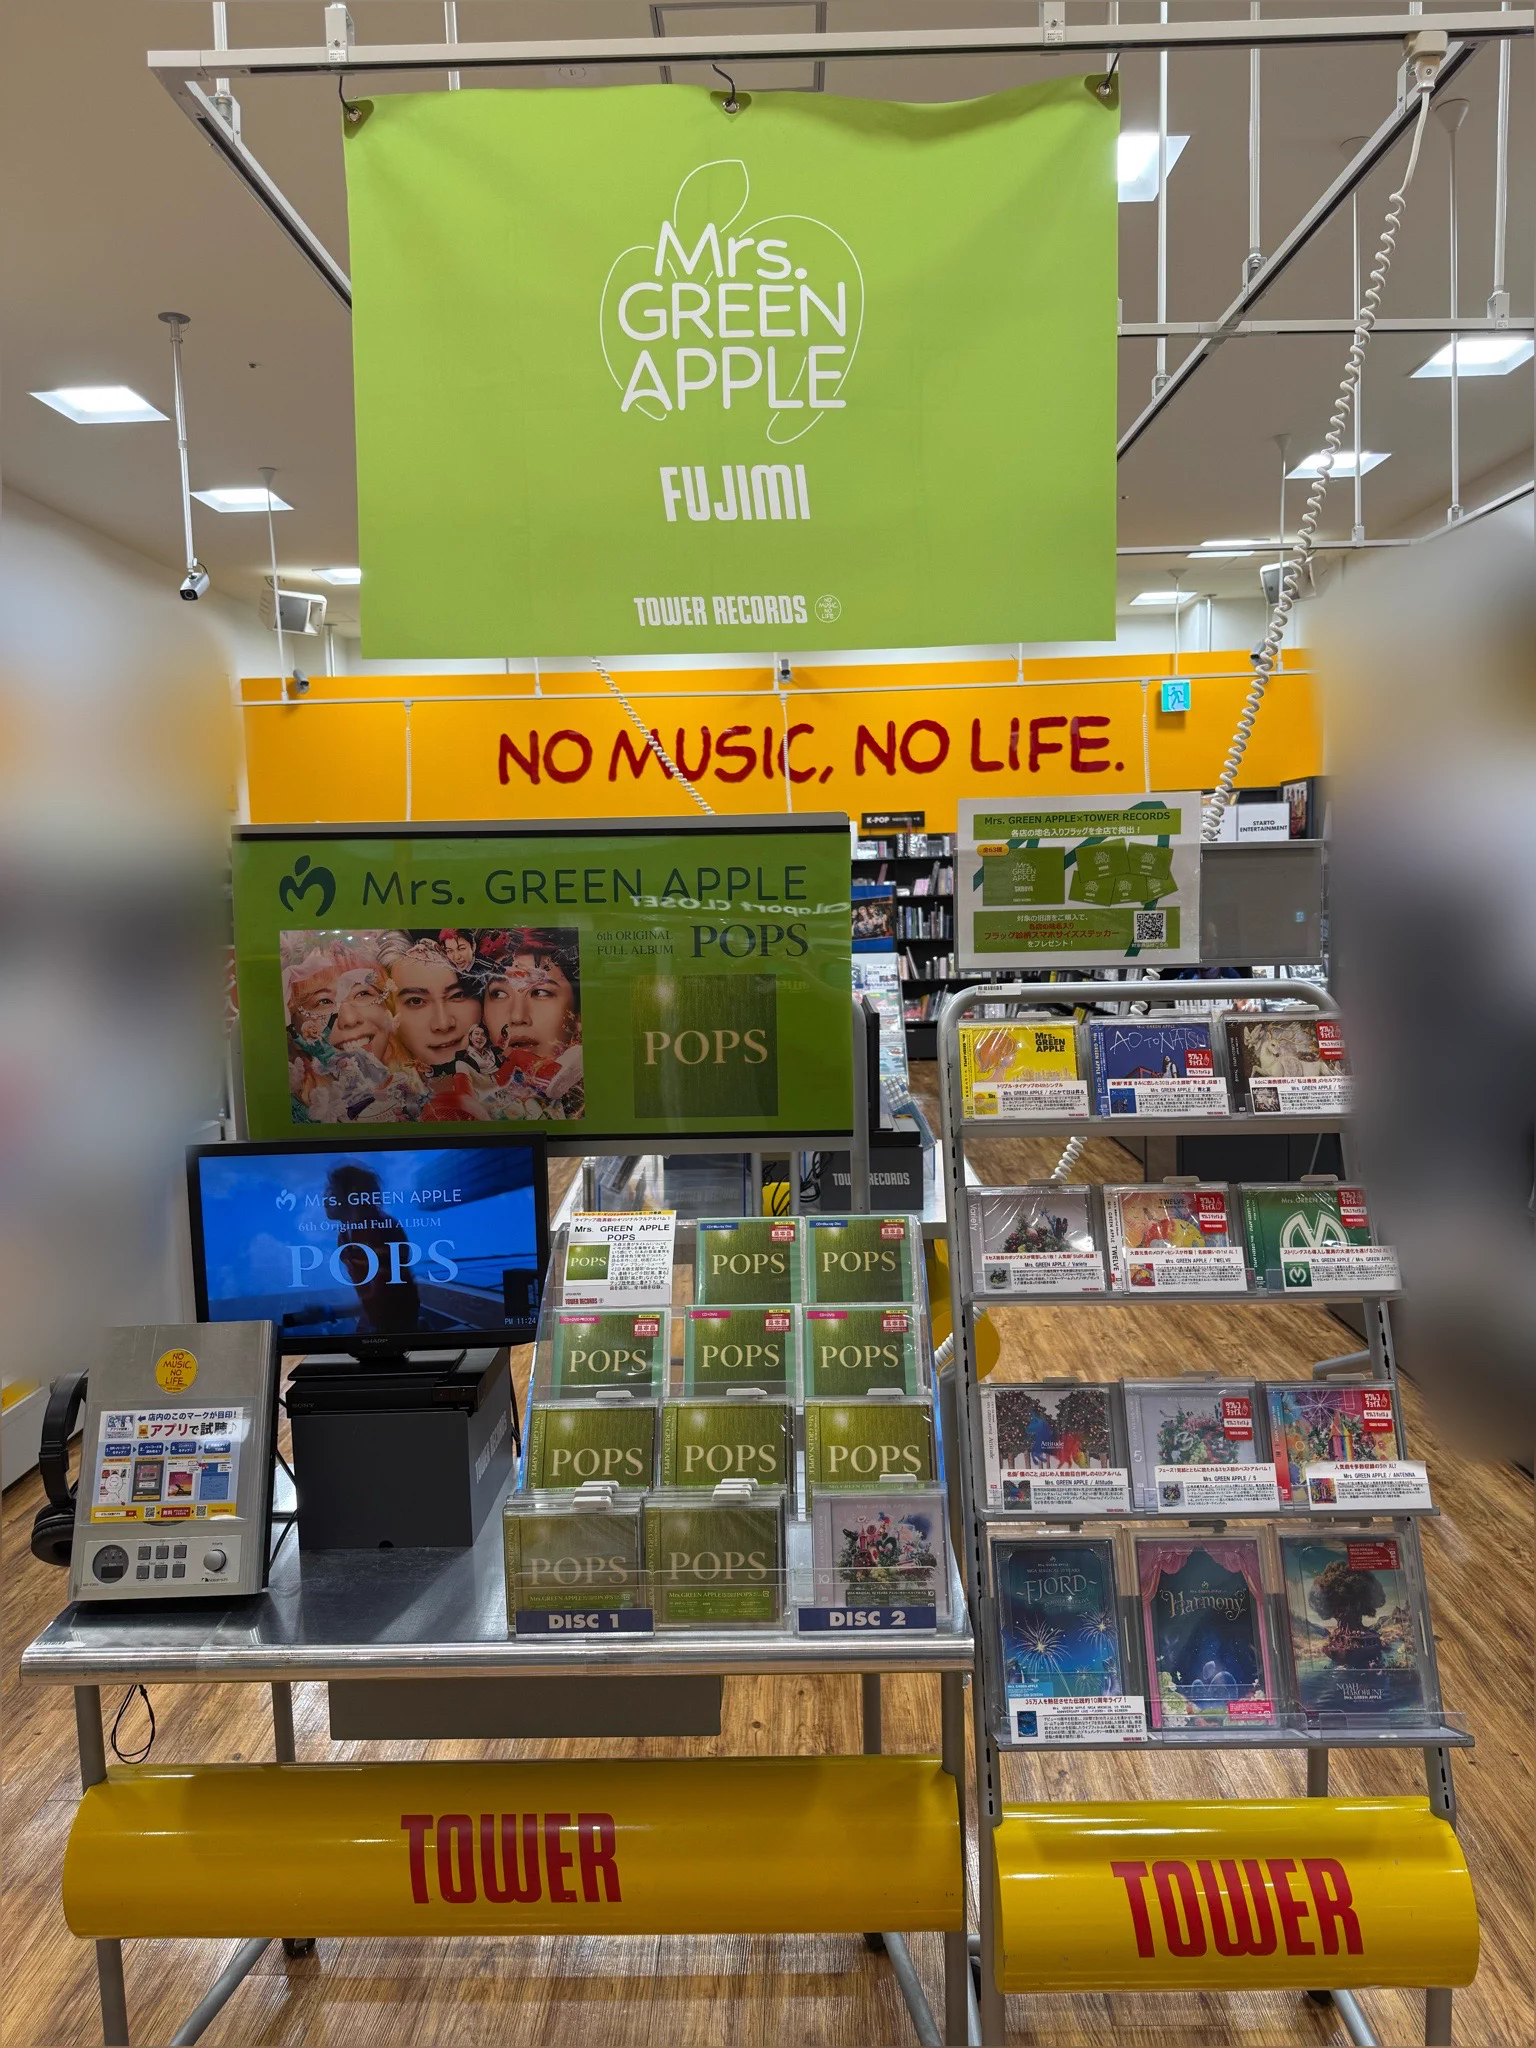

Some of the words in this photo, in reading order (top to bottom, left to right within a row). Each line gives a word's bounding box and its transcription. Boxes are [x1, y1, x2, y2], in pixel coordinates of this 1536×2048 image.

[655, 221, 807, 279] Mrs.
[618, 282, 846, 341] GREEN
[621, 346, 846, 412] APPLE
[660, 464, 811, 522] FUJIMI
[634, 597, 708, 626] TOWER
[712, 595, 808, 625] RECORDS
[499, 729, 593, 784] NO
[609, 724, 834, 784] MUSIC,
[855, 719, 951, 775] NO
[970, 715, 1125, 773] LIFE.
[866, 816, 890, 824] K-POP
[984, 817, 1005, 825] Mrs.
[1008, 816, 1042, 824] GREEN
[1122, 811, 1171, 821] RECORDS
[362, 871, 464, 906] Mrs.
[485, 868, 642, 905] GREEN
[662, 865, 808, 902] APPLE
[1012, 874, 1036, 882] APPLE
[596, 930, 612, 942] 6th
[615, 929, 674, 942] ORIGINAL
[690, 923, 809, 959] POPS
[597, 945, 627, 956] FULL
[631, 944, 674, 956] ALBUM
[643, 1028, 769, 1066] POPS
[1036, 1045, 1065, 1053] APPLE
[869, 1172, 910, 1185] RECORDS
[304, 1194, 342, 1207] Mrs.
[348, 1191, 404, 1206] GREEN
[410, 1189, 462, 1204] APPLE
[298, 1221, 317, 1232] 6th
[320, 1219, 368, 1233] Original
[371, 1219, 392, 1230] Full
[396, 1217, 441, 1228] ALBUM
[286, 1239, 459, 1288] POPS
[570, 1256, 607, 1267] POPS
[712, 1252, 786, 1275] POPS
[822, 1250, 897, 1273] POPS
[1111, 1245, 1119, 1271] TWELVE
[568, 1349, 647, 1373] POPS
[701, 1344, 780, 1368] POPS
[820, 1344, 899, 1368] POPS
[148, 1411, 237, 1421] 店内のこのマークが目印!
[550, 1447, 644, 1476] POPS
[684, 1444, 777, 1473] POPS
[828, 1445, 922, 1473] POPS
[1134, 1450, 1142, 1462] 5
[529, 1556, 628, 1585] POPS
[669, 1551, 767, 1580] POPS
[1160, 1588, 1247, 1621] Harmony
[549, 1614, 599, 1629] DISC
[609, 1613, 619, 1628] 1
[829, 1611, 881, 1626] DISC
[890, 1610, 906, 1625] 2
[401, 1813, 622, 1904] TOWER
[1110, 1858, 1364, 1958] TOWER
